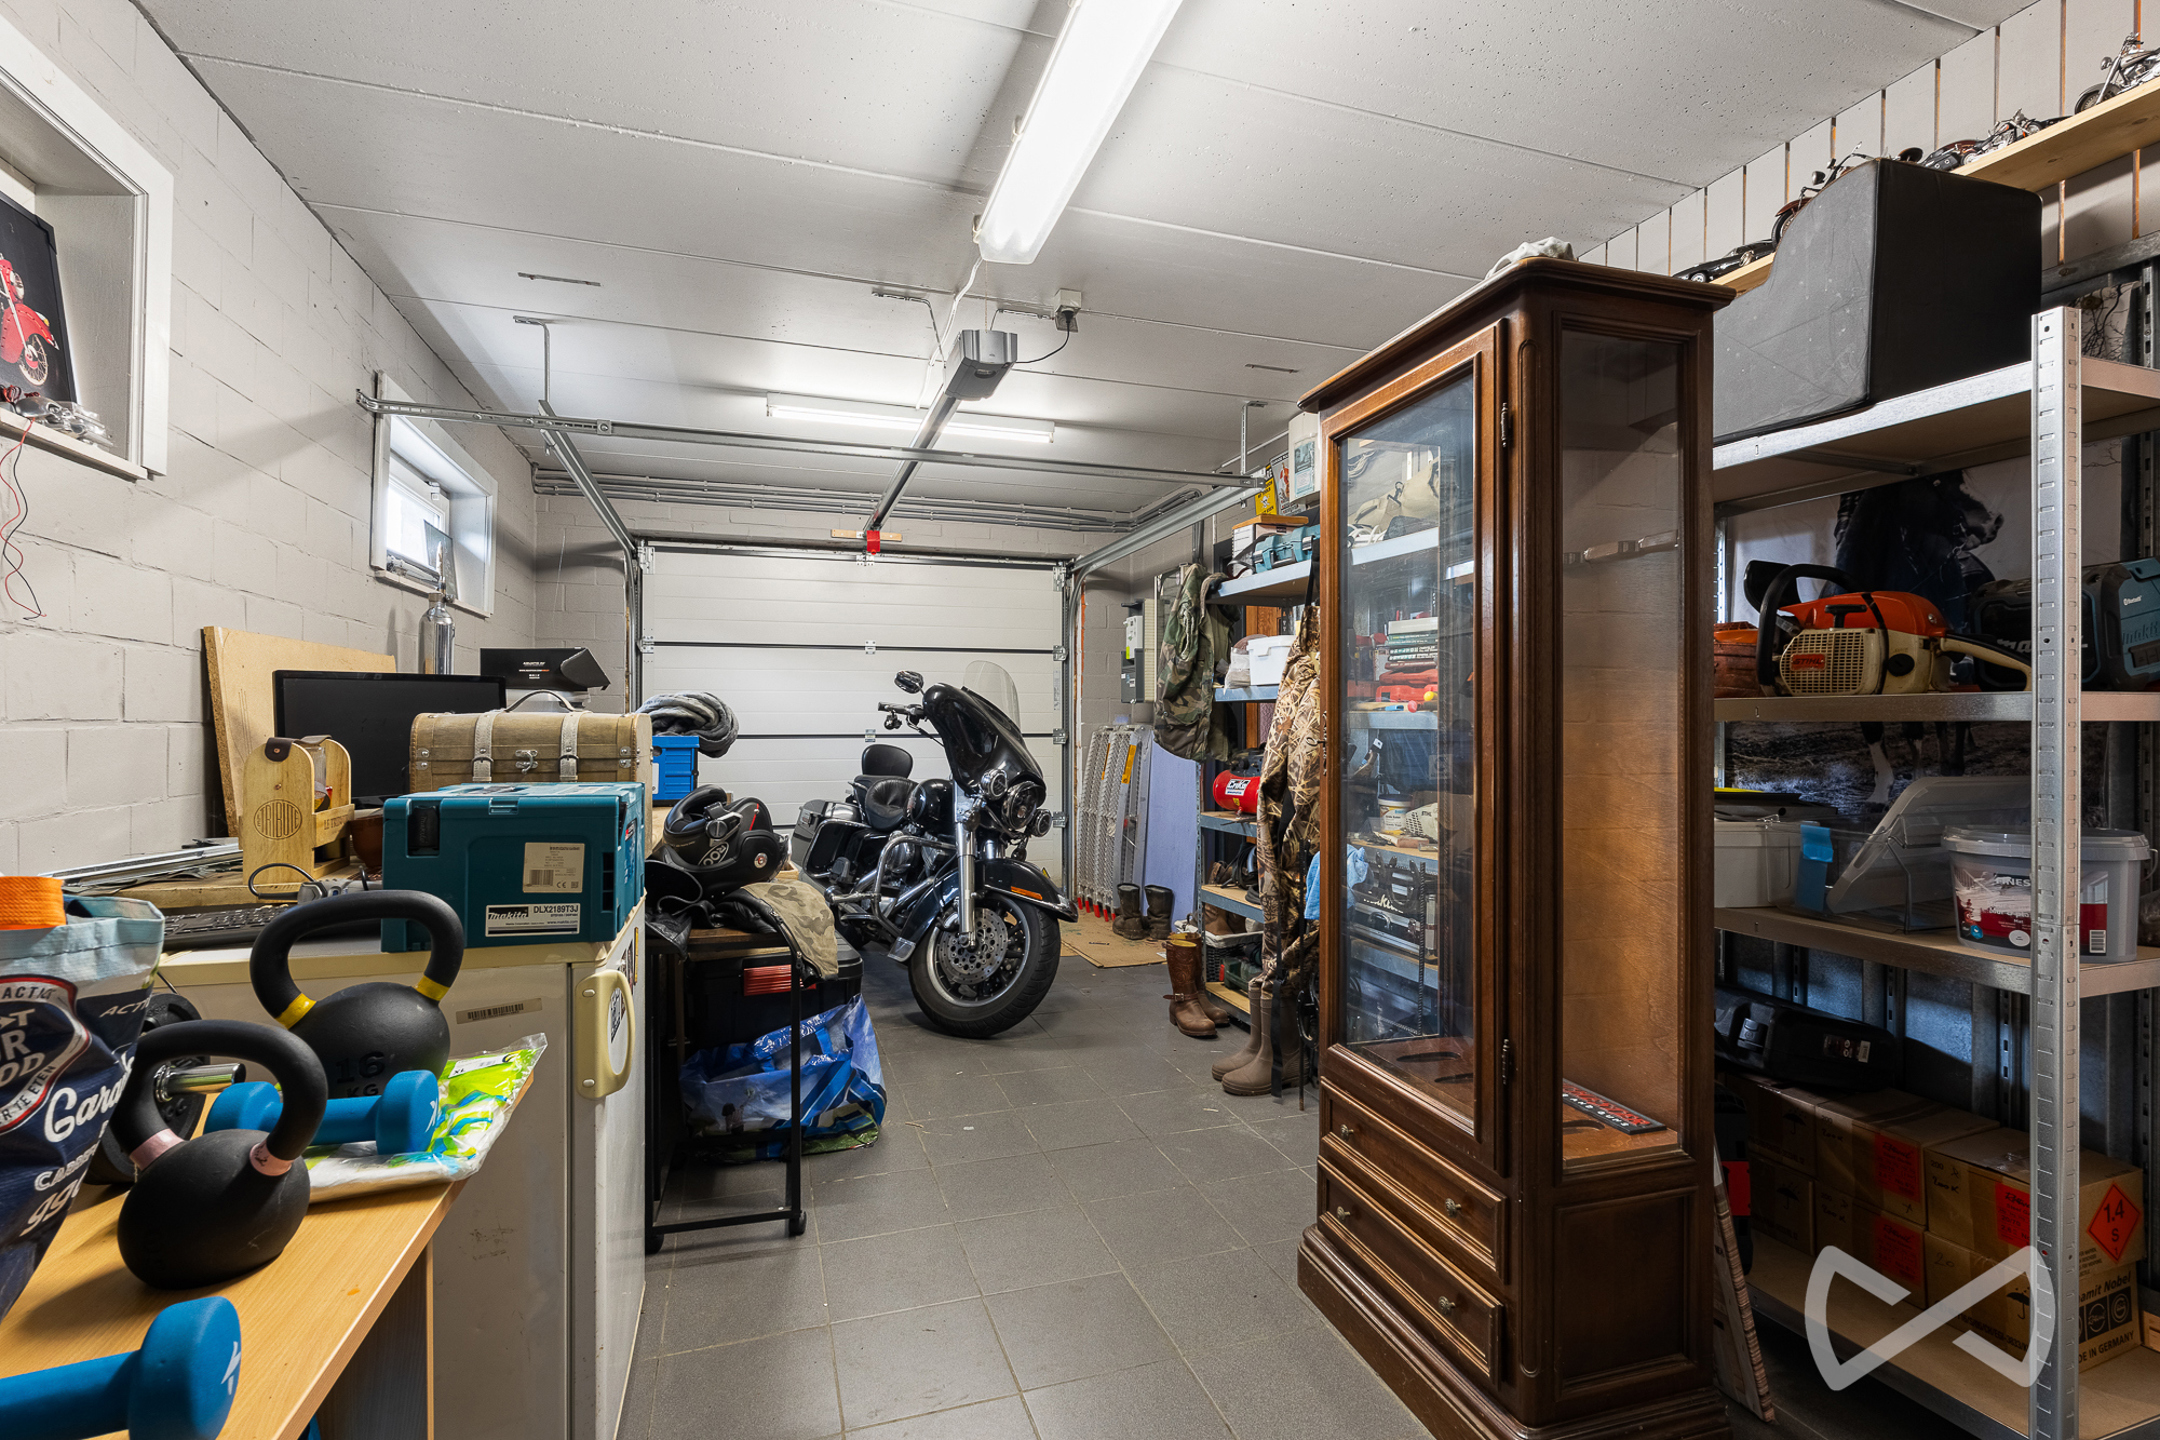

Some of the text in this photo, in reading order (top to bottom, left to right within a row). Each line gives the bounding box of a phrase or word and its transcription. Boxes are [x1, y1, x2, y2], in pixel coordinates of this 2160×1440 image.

[259, 801, 299, 838] TRIBUTE
[488, 905, 579, 920] makita DLX2189T3J
[26, 1065, 56, 1096] ETEN
[335, 1051, 386, 1085] 16
[2103, 1198, 2125, 1224] 1.4
[2111, 1228, 2119, 1242] S
[2104, 1269, 2132, 1292] Nobel
[2089, 1344, 2098, 1359] IN
[2099, 1330, 2136, 1355] GERMANY
